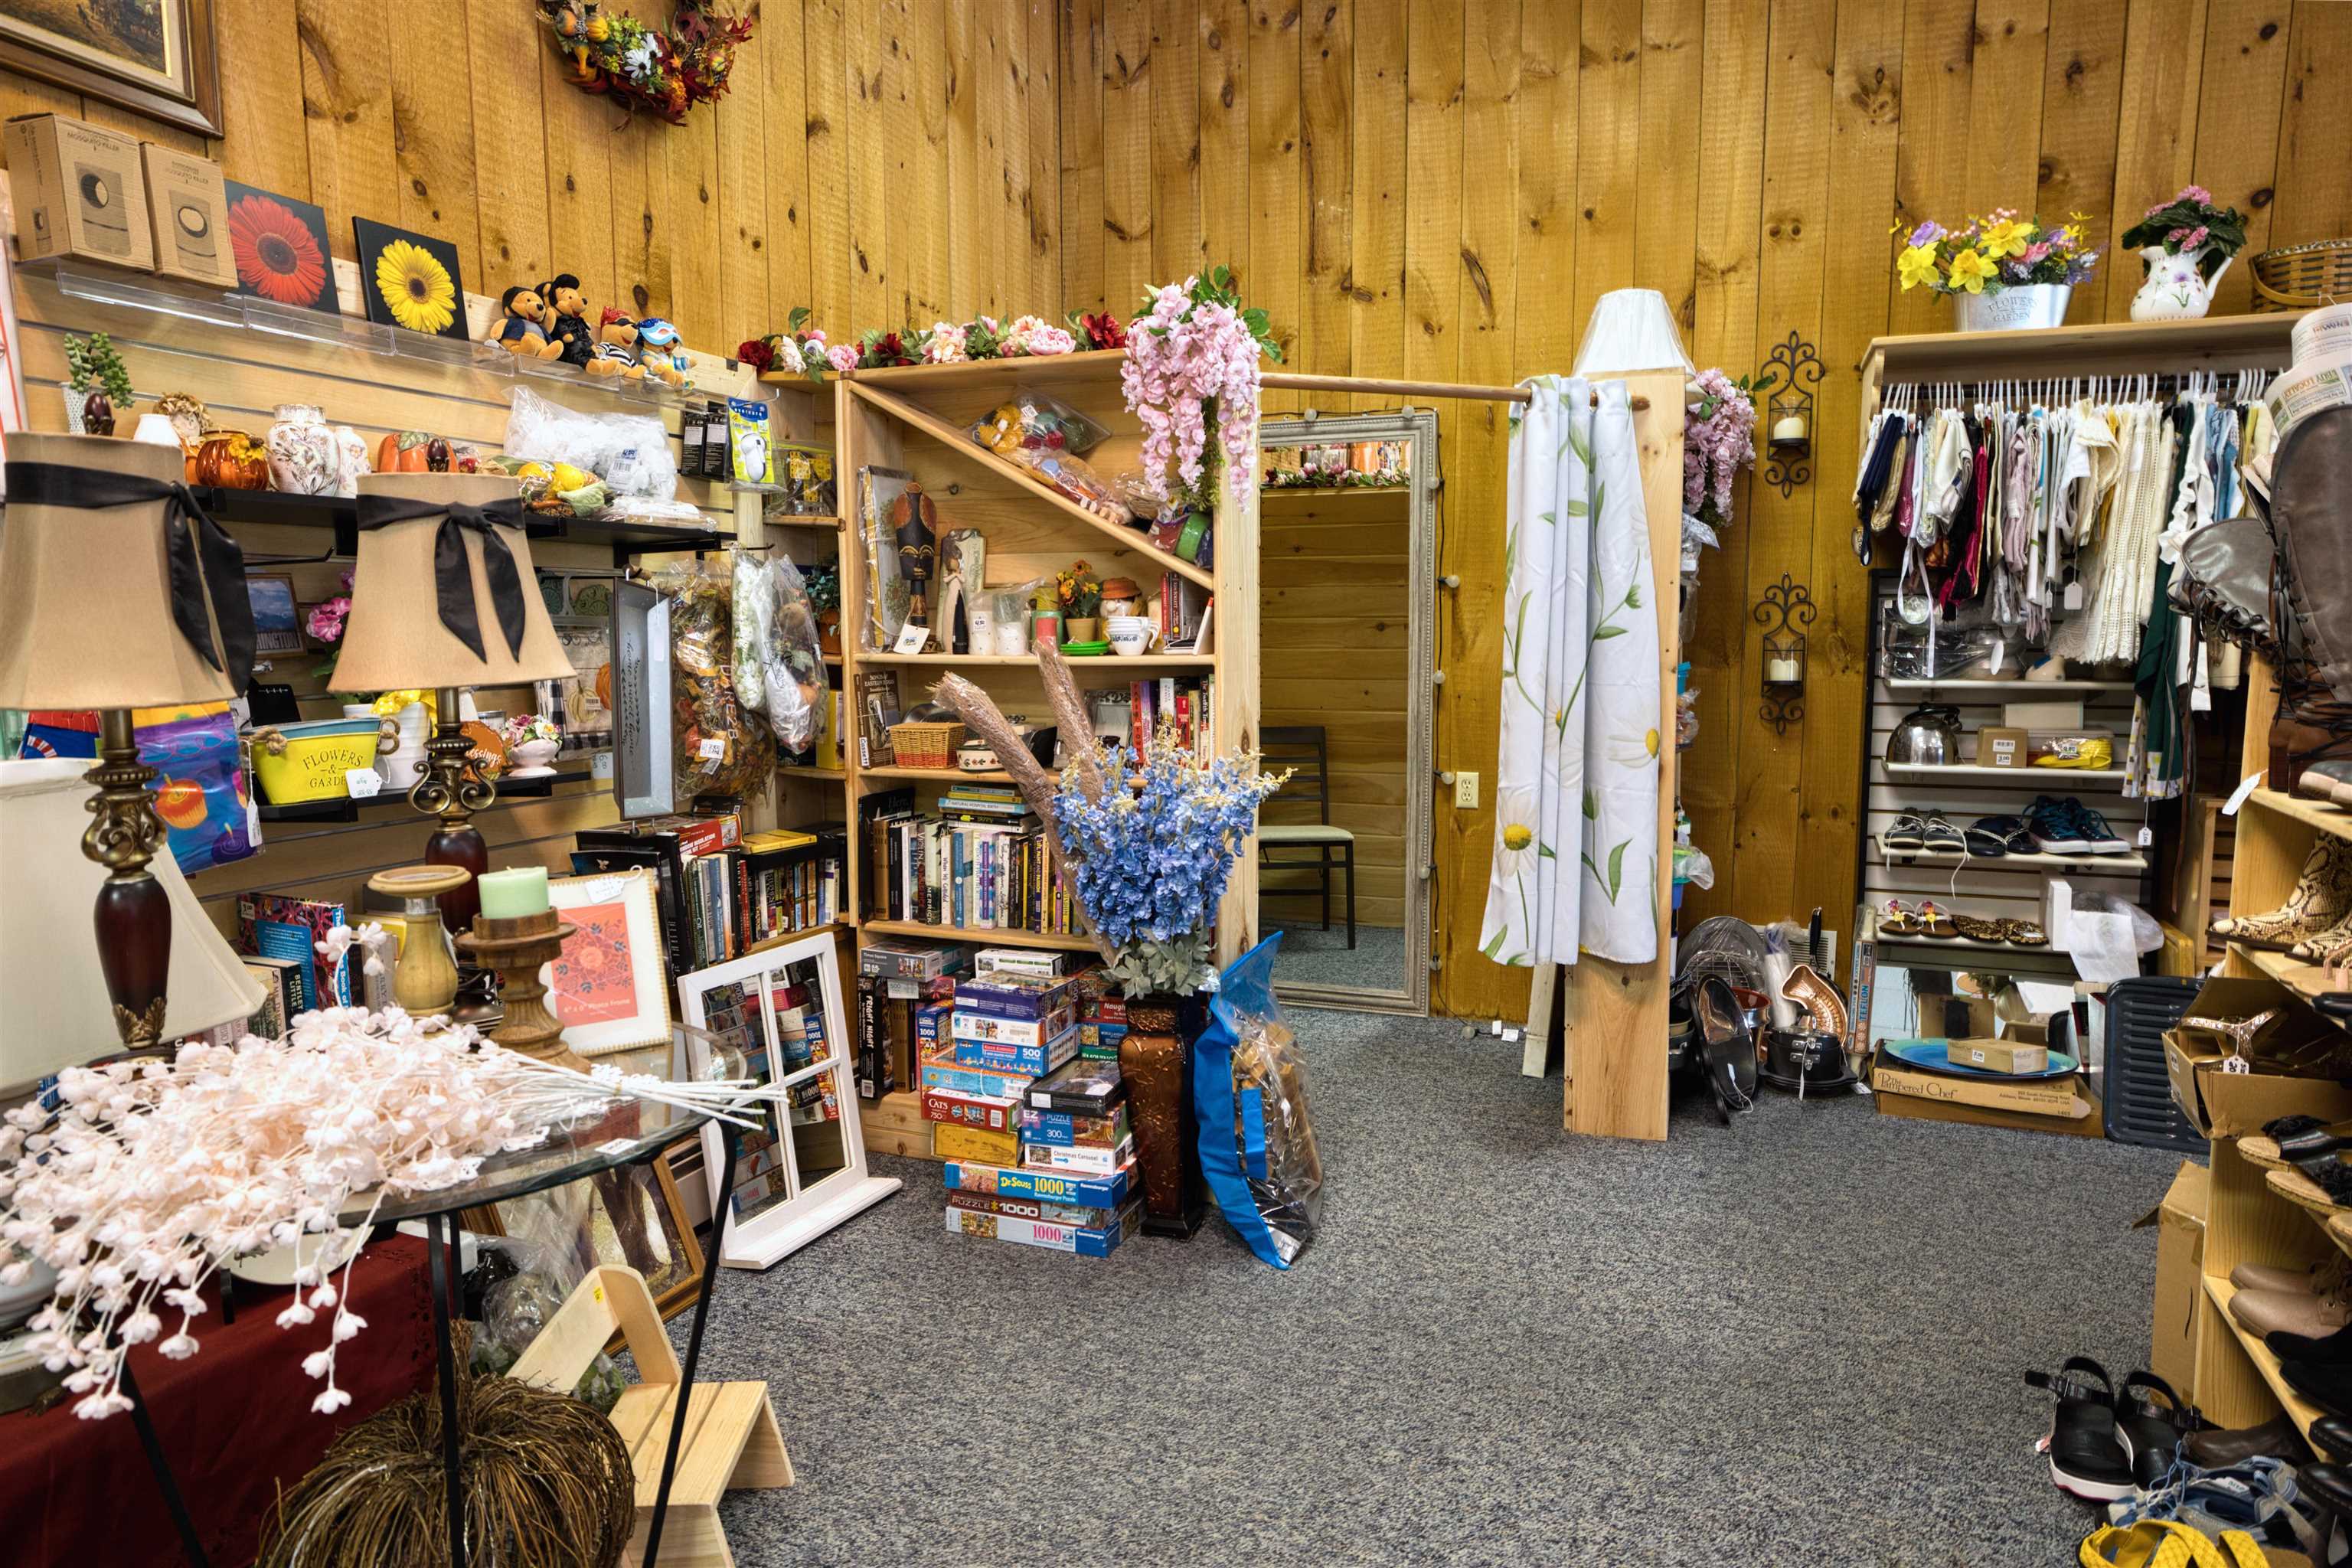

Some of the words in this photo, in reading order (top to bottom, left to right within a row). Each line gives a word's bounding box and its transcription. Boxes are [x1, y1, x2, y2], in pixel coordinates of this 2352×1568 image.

[302, 750, 364, 770] FLOWERS
[465, 747, 502, 768] essings
[328, 764, 336, 774] &
[309, 776, 348, 788] GARDE
[289, 980, 297, 1007] LITTLE
[294, 974, 303, 1010] BENTLEY
[1103, 1002, 1125, 1011] Naugh
[1859, 985, 1870, 1022] TEFLON
[866, 1024, 874, 1049] NIGHT
[919, 1028, 936, 1037] 1000
[1022, 1047, 1041, 1057] 500
[1877, 1072, 1924, 1094] Pampered
[1926, 1082, 1958, 1099] Chef
[929, 1098, 949, 1110] CATS
[929, 1111, 942, 1120] 750
[1023, 1109, 1038, 1119] EZ
[1047, 1114, 1071, 1123] PUZZLE
[1047, 1129, 1063, 1138] 300
[1054, 1151, 1076, 1159] Christmas
[1077, 1153, 1099, 1162] Carousel
[1011, 1178, 1032, 1190] Seuss
[1034, 1178, 1064, 1195] 1000
[952, 1196, 991, 1210] PUZZLE
[998, 1202, 1039, 1217] 1000
[1033, 1224, 1062, 1243] 1000
